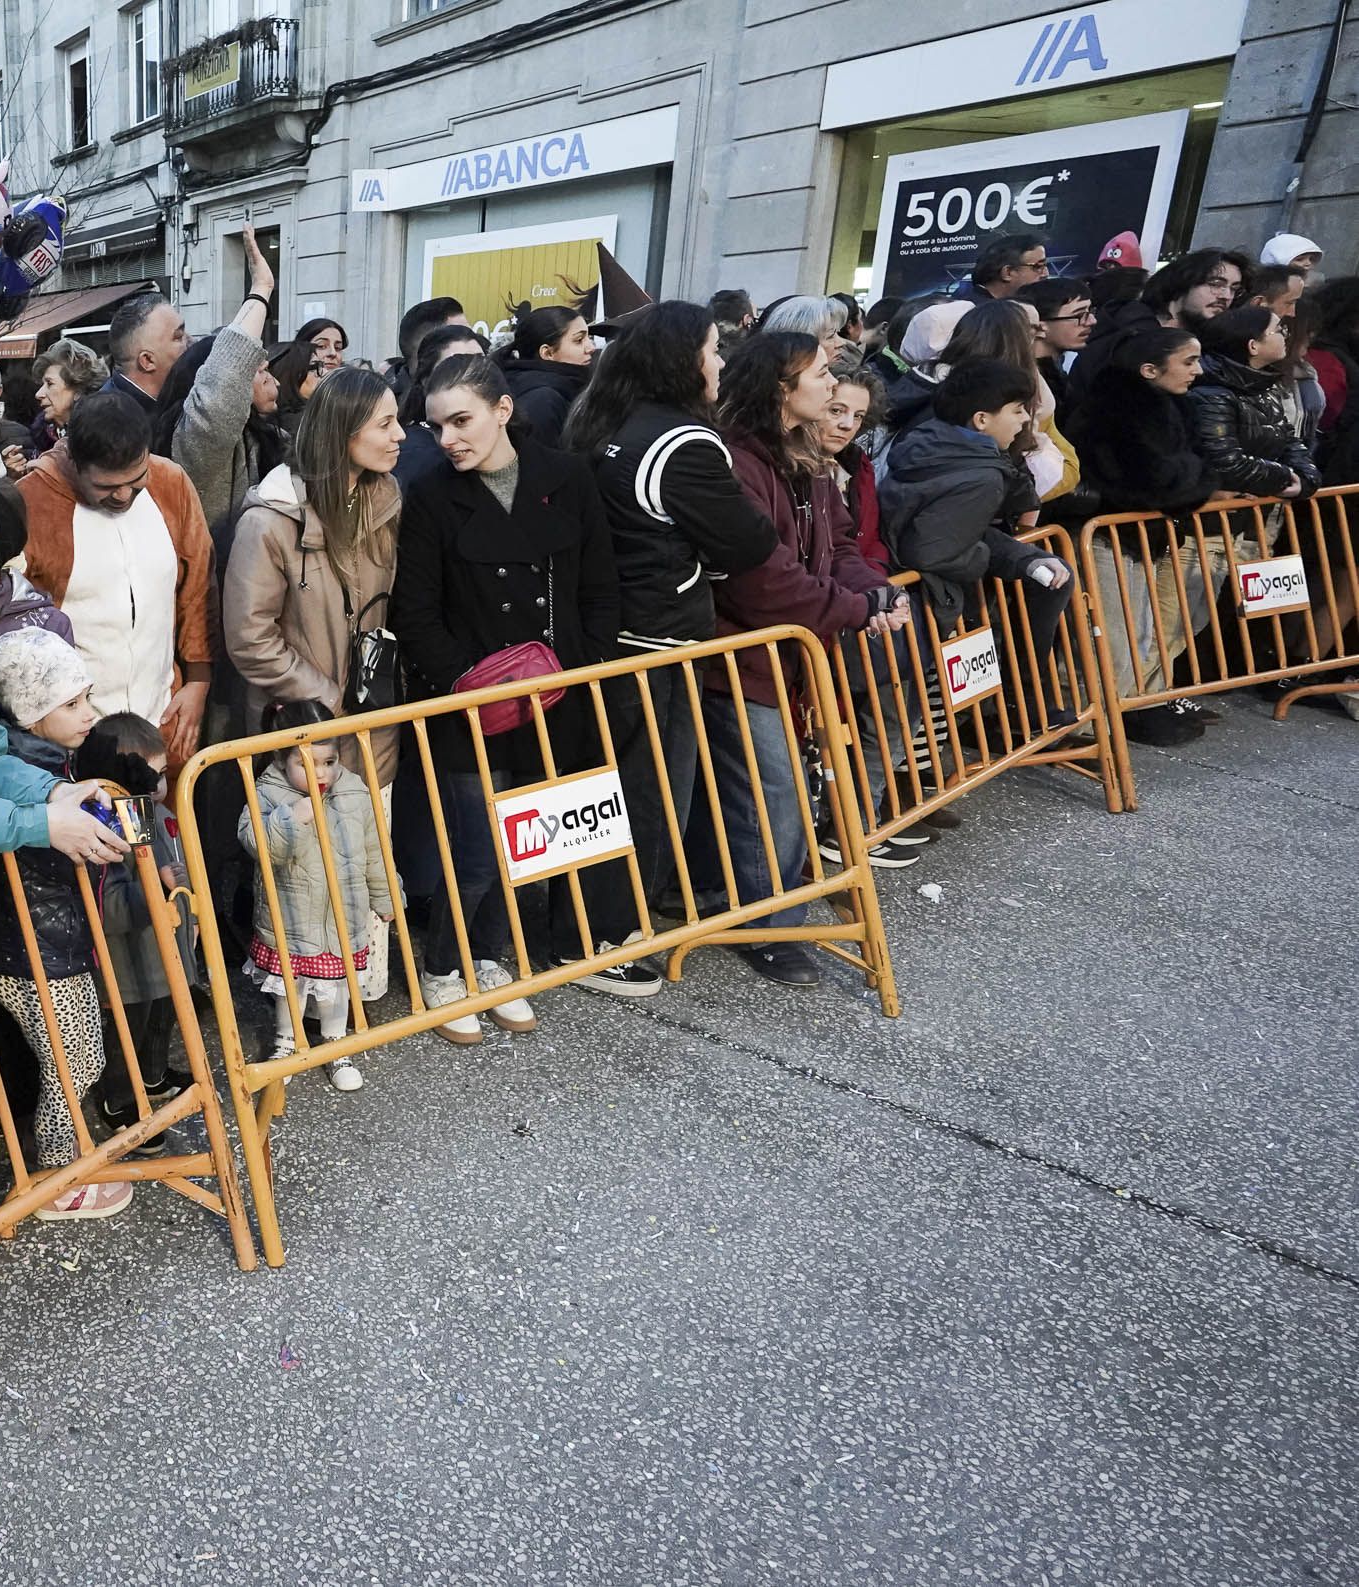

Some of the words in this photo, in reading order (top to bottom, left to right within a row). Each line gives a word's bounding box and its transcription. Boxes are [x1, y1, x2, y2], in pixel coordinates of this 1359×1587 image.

[942, 243, 978, 252] autónomo
[949, 234, 976, 243] nómina
[29, 249, 53, 275] FAST
[531, 284, 558, 297] Crece
[1242, 569, 1304, 599] Myagal
[514, 792, 622, 856] Myagal
[563, 828, 611, 848] ALQUILER
